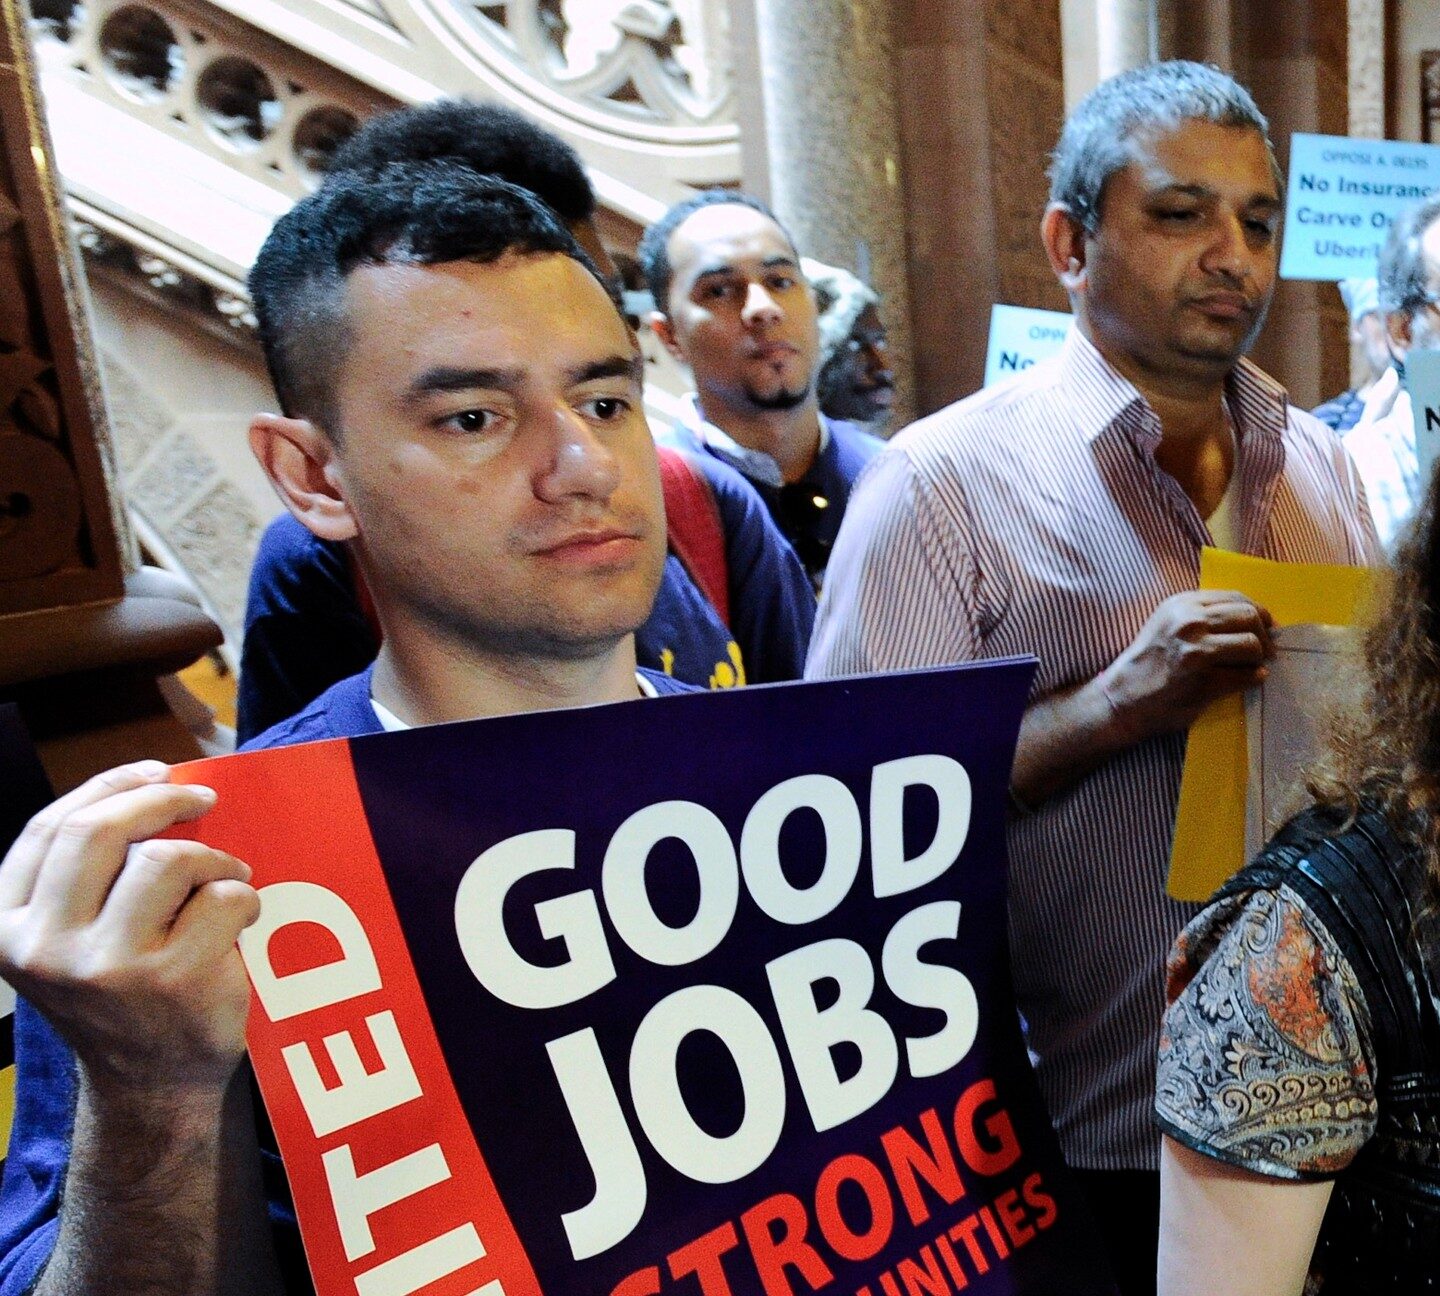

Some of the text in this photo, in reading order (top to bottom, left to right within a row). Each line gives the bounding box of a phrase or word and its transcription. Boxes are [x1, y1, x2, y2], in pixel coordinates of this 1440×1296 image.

[1298, 207, 1361, 226] Carve
[1301, 174, 1432, 198] No Insuranc
[454, 754, 972, 1009] GOOD
[237, 881, 506, 1296] ITED
[545, 901, 979, 1262] JOBS
